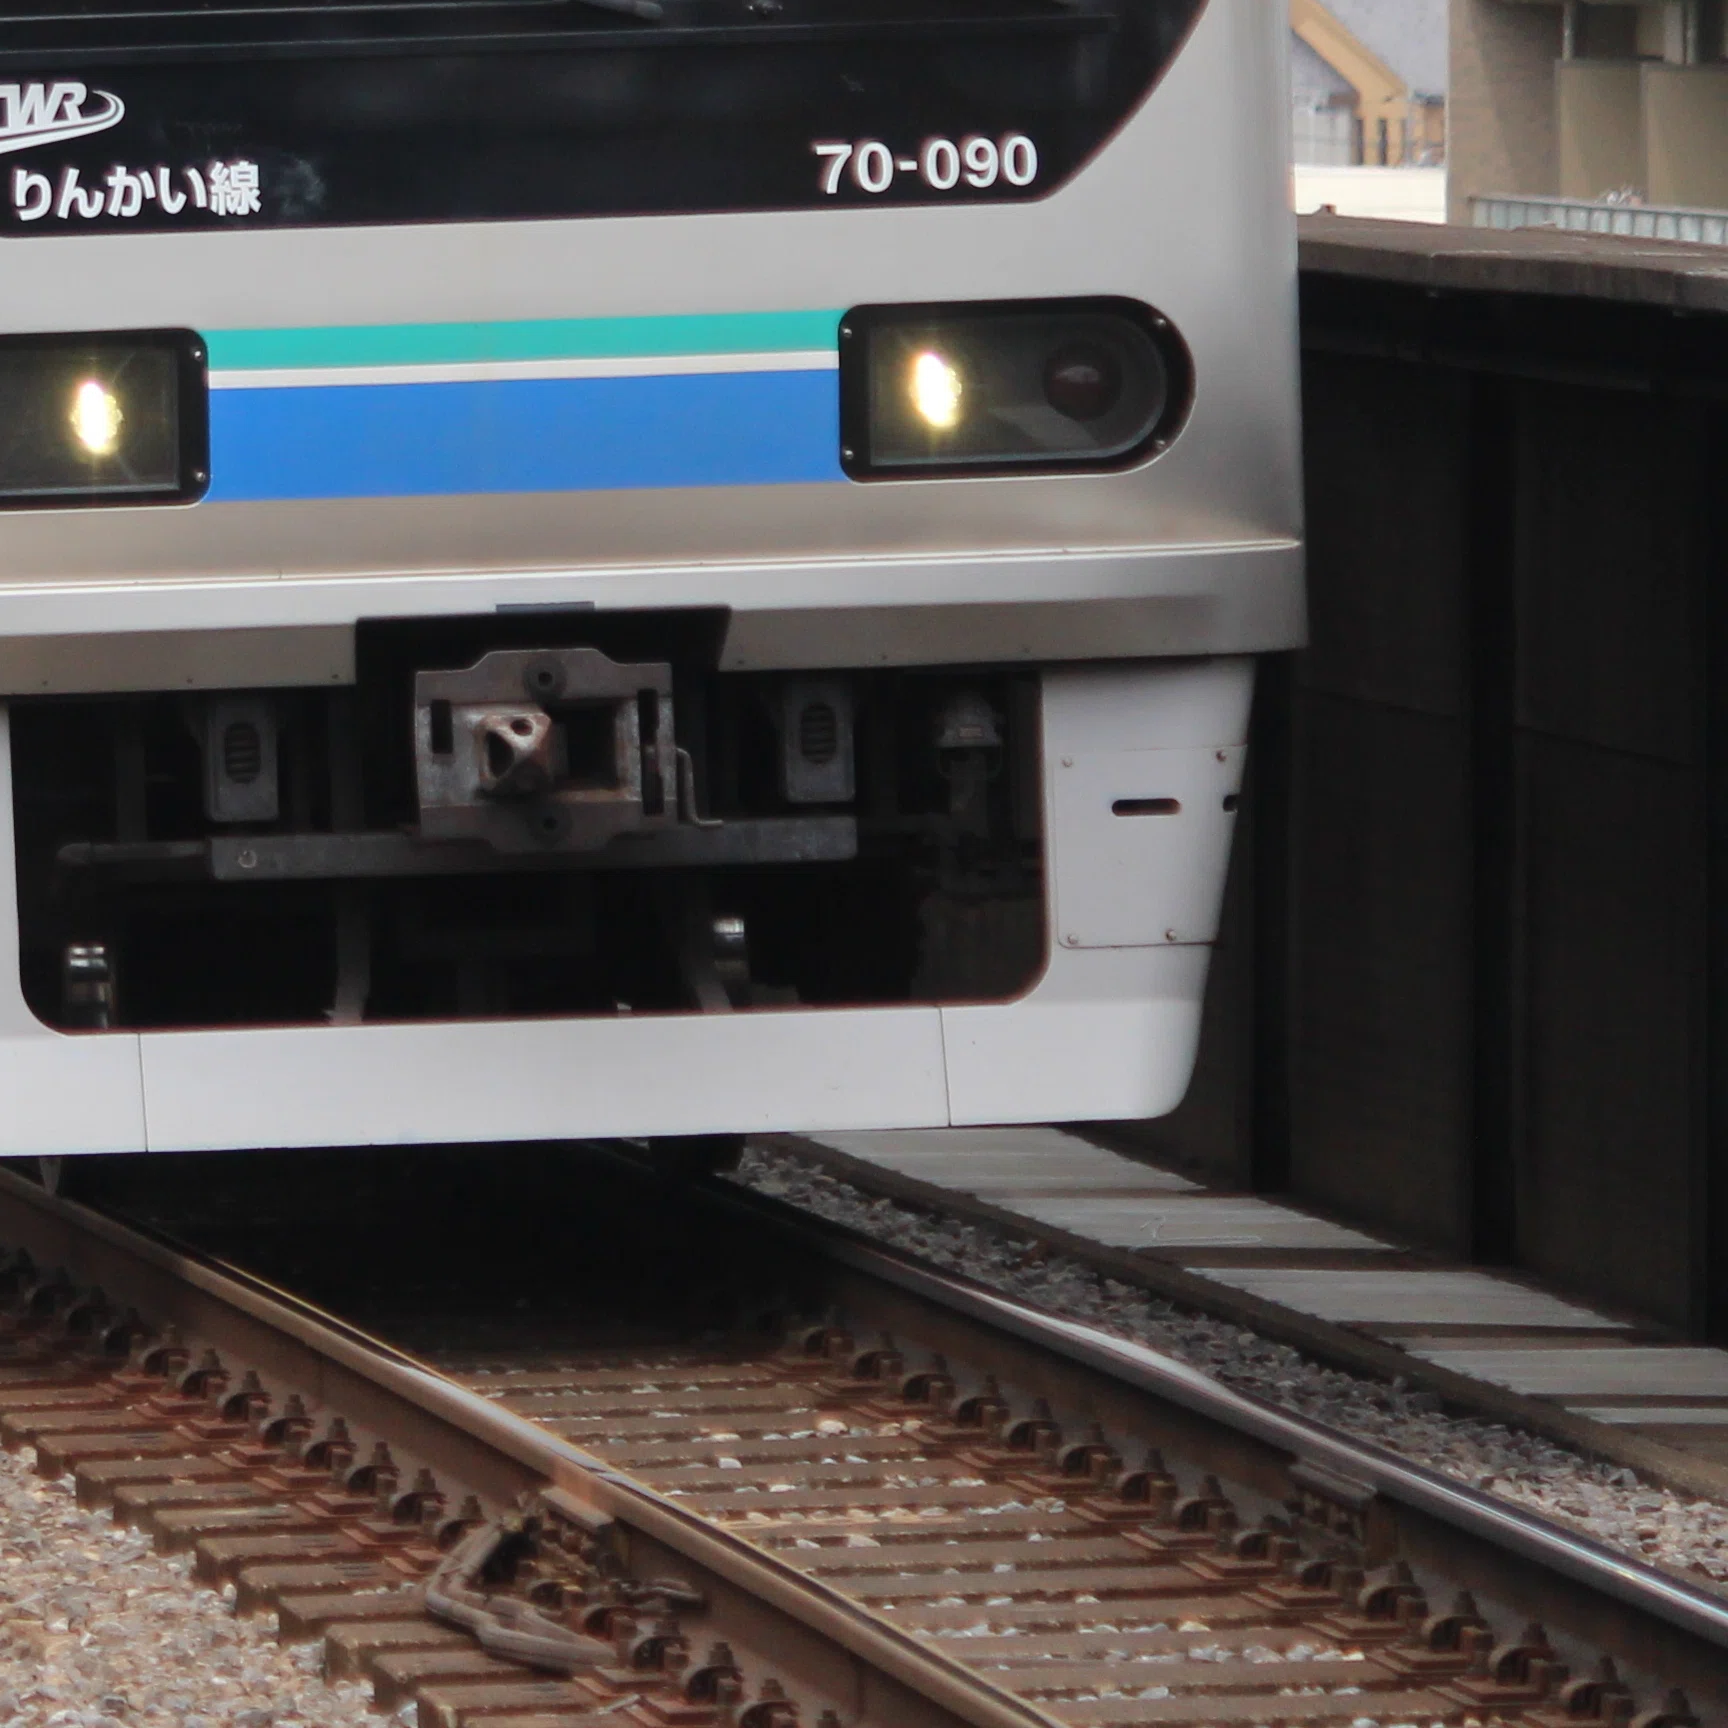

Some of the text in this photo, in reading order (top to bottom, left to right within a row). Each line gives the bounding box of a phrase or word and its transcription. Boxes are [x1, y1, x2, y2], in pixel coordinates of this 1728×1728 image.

[15, 160, 262, 222] りんかい線
[815, 135, 1038, 195] 70-090
